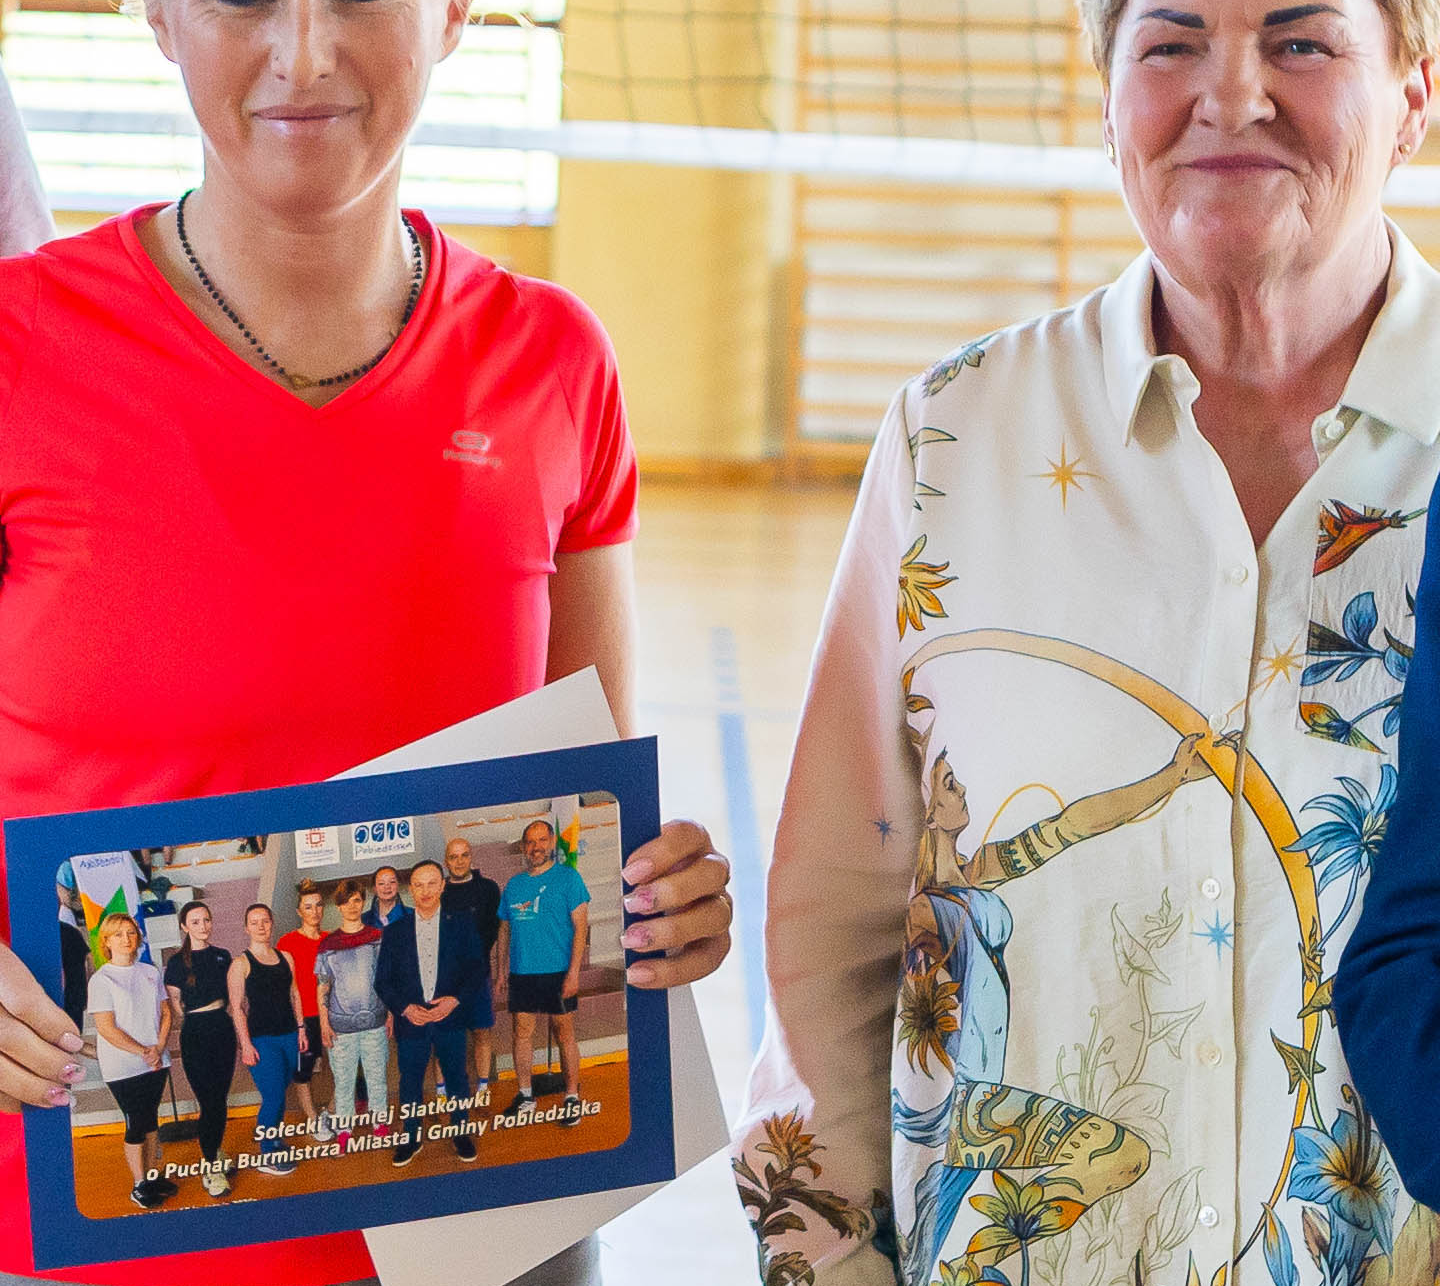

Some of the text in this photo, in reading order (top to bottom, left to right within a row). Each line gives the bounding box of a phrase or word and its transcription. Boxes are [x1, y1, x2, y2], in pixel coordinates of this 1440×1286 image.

[146, 1099, 602, 1181] o Puchar Burmistrza Miasta i Gminy Pobiedziska
[253, 1090, 491, 1141] Sołecki Turniej Siatkówki
